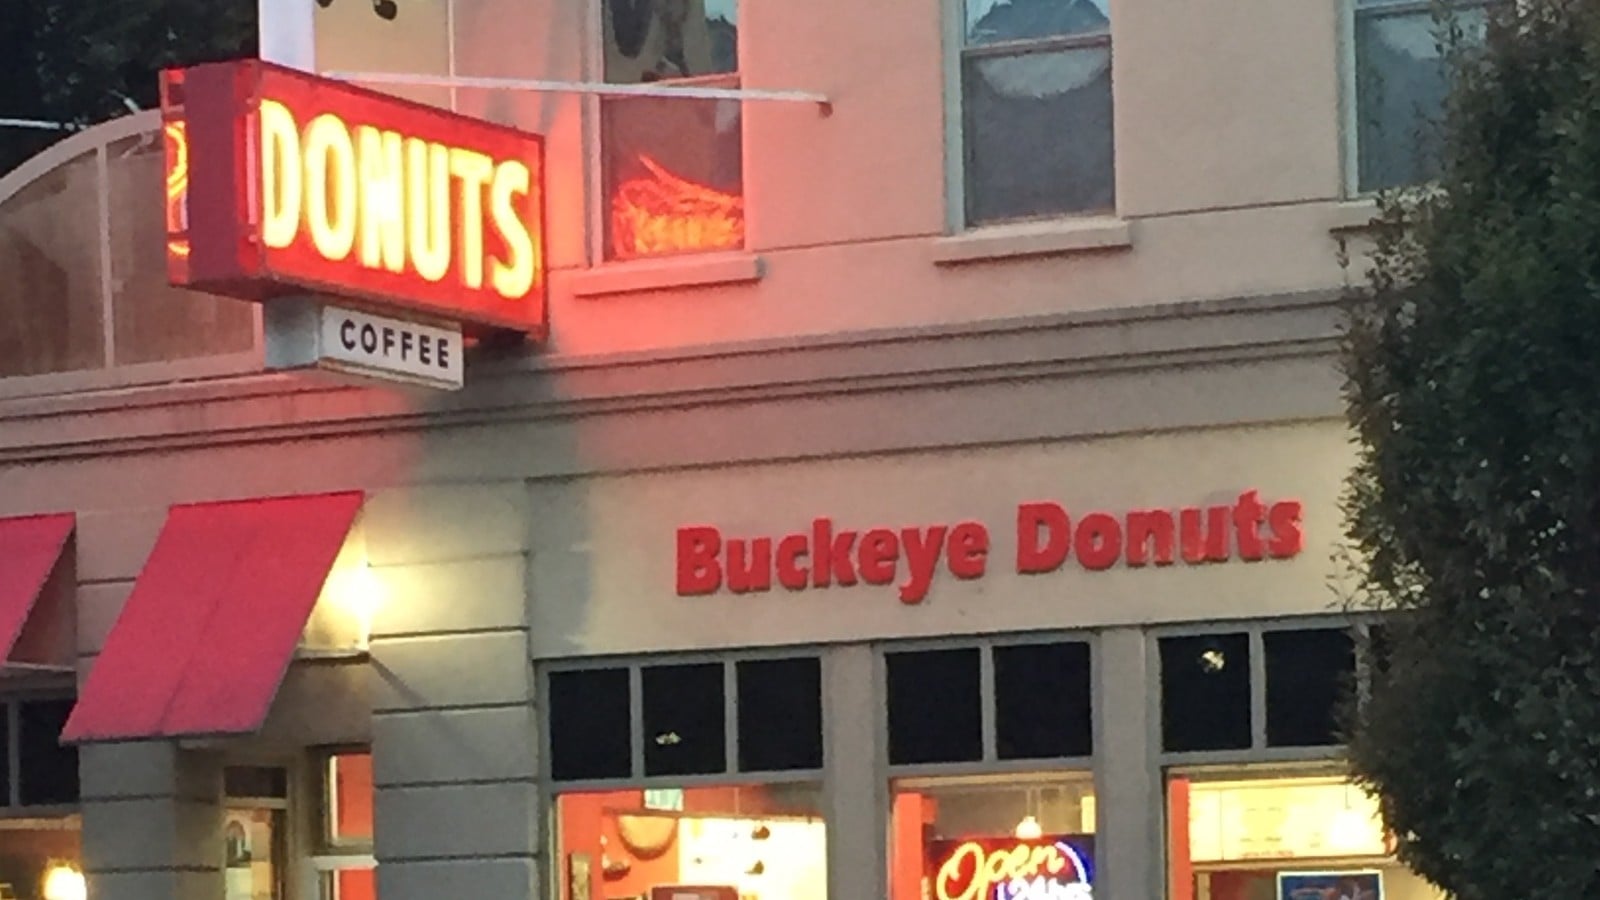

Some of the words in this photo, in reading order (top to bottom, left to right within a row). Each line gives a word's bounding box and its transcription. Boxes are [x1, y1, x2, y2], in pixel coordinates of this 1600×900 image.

[260, 99, 534, 298] DONUTS
[340, 319, 450, 368] COFFEE
[676, 518, 988, 603] Buckeye
[1016, 490, 1305, 573] Donuts
[936, 841, 1065, 900] Open
